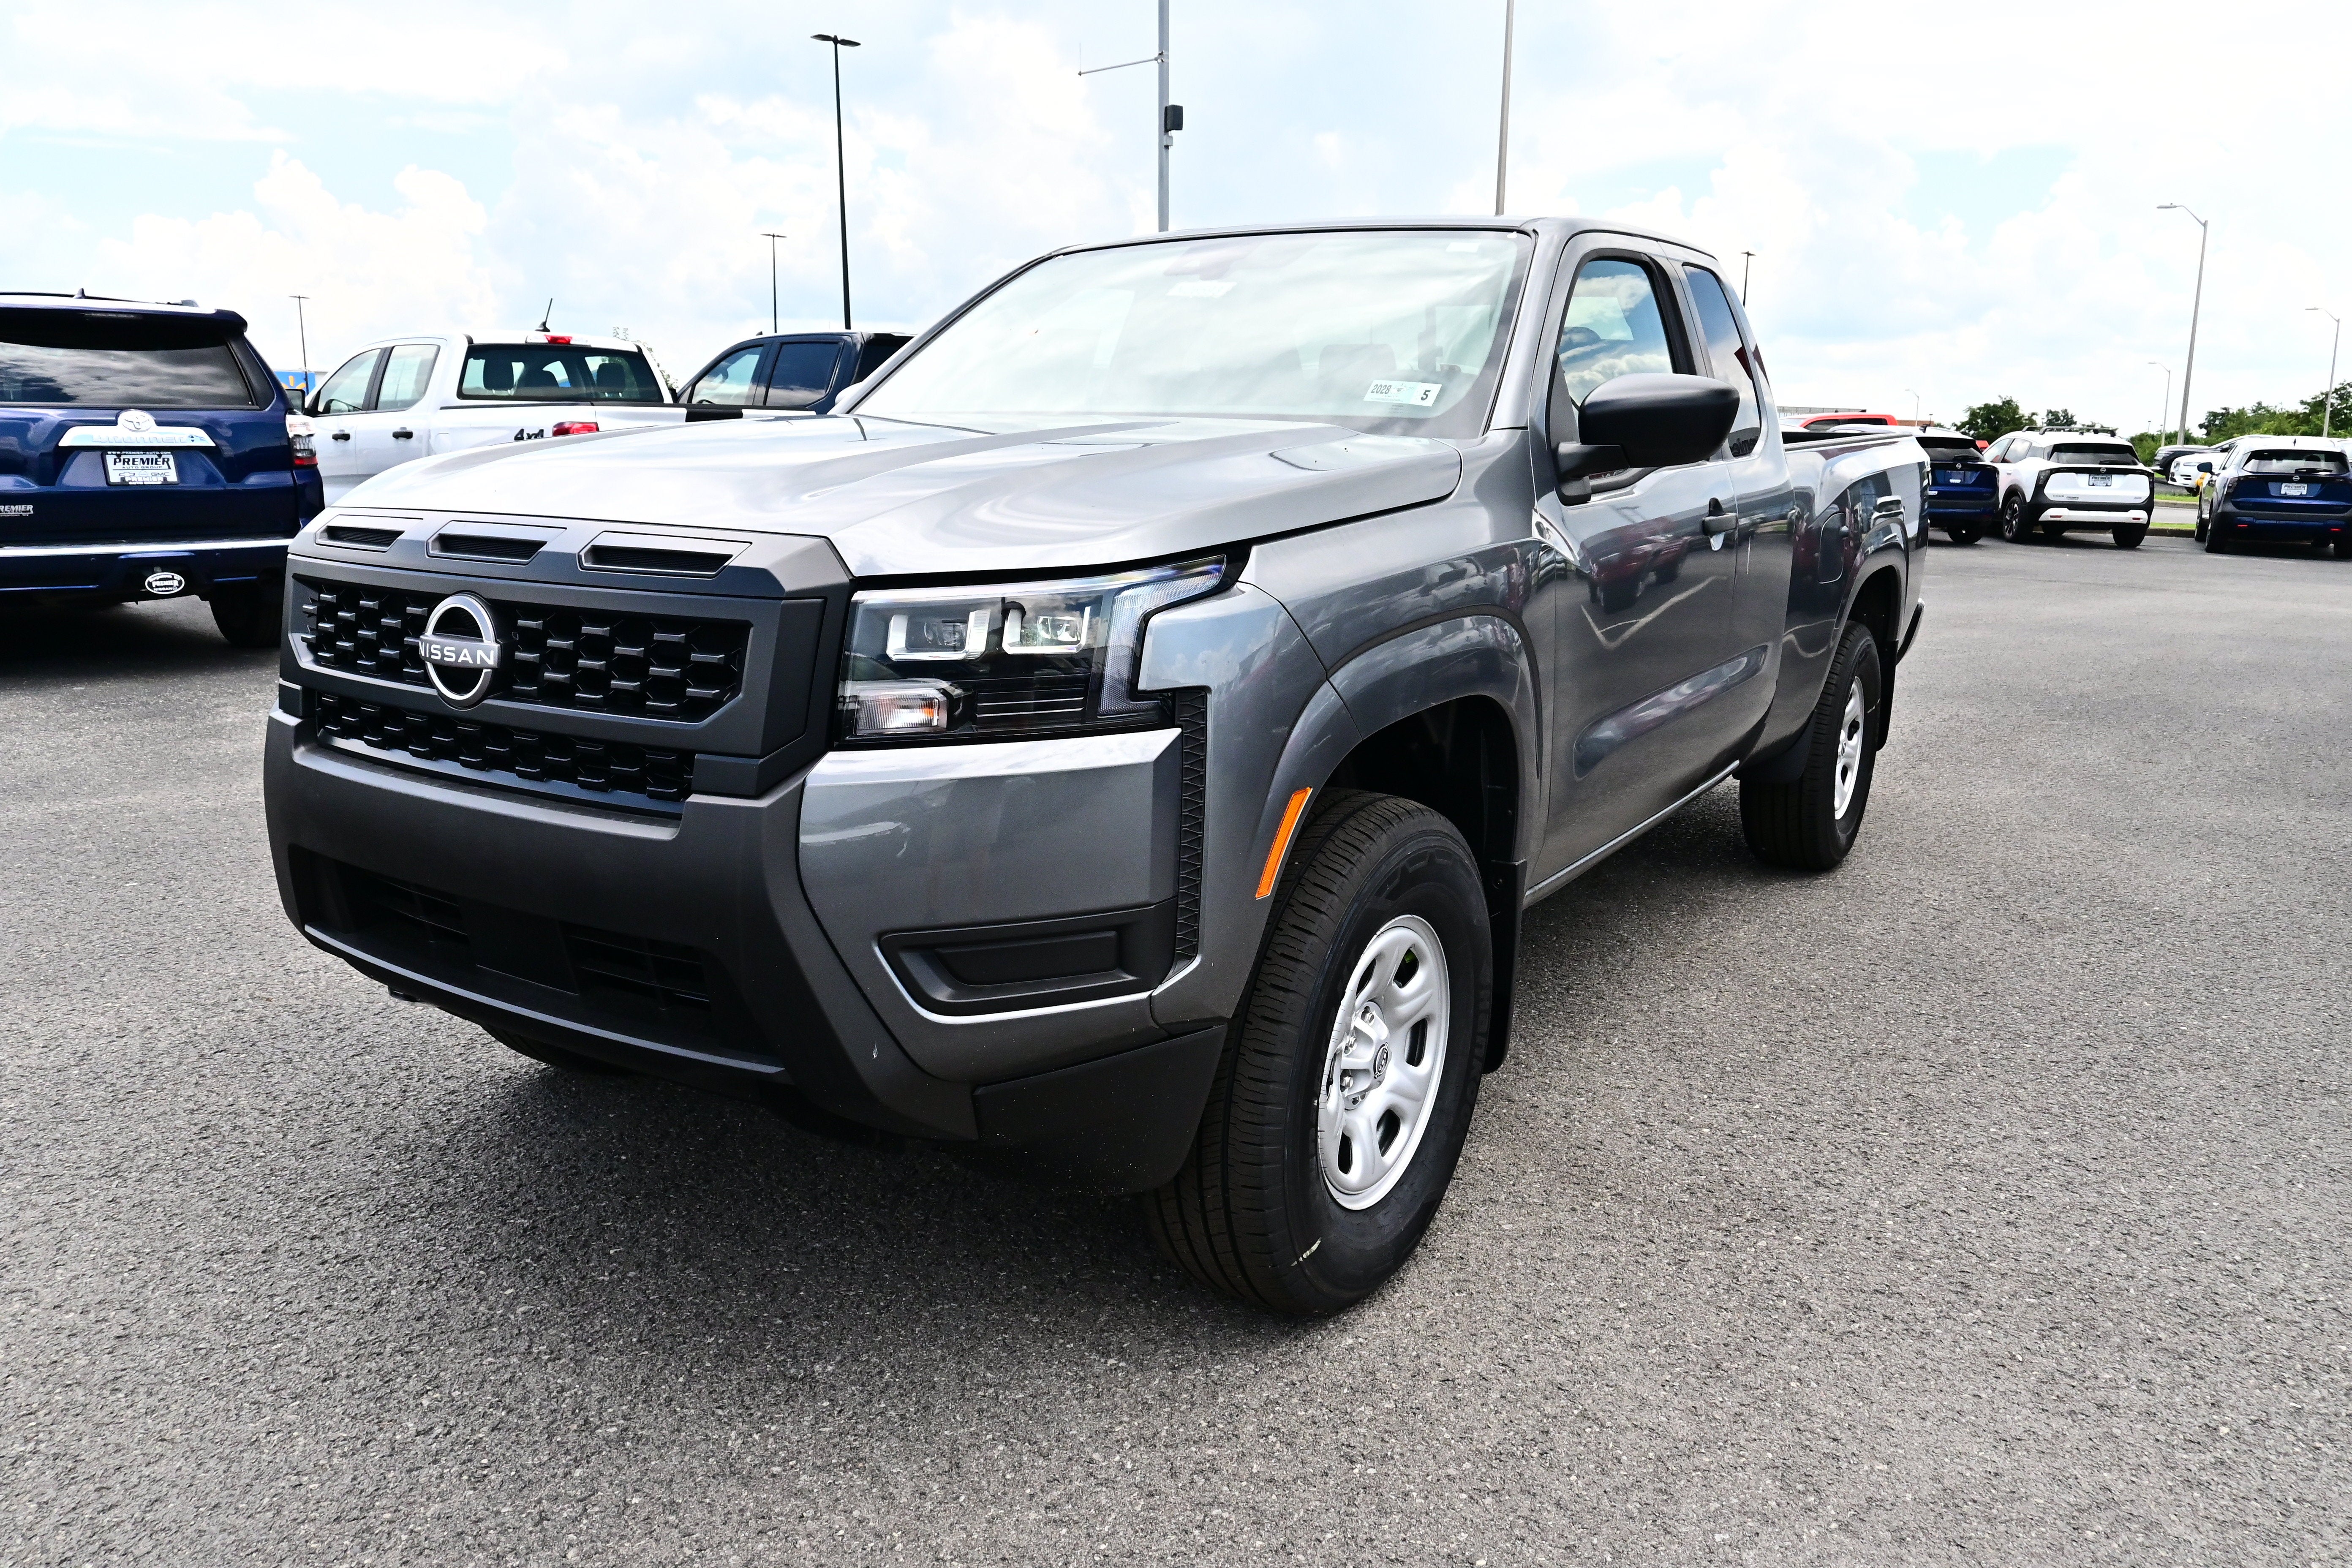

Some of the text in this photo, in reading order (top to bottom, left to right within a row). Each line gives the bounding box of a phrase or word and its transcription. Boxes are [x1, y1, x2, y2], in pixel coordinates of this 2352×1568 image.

[1371, 384, 1391, 394] 2028
[1421, 389, 1431, 401] 5
[114, 457, 171, 469] PREMIER
[0, 505, 33, 514] REMIER
[419, 640, 494, 665] NISSAN
